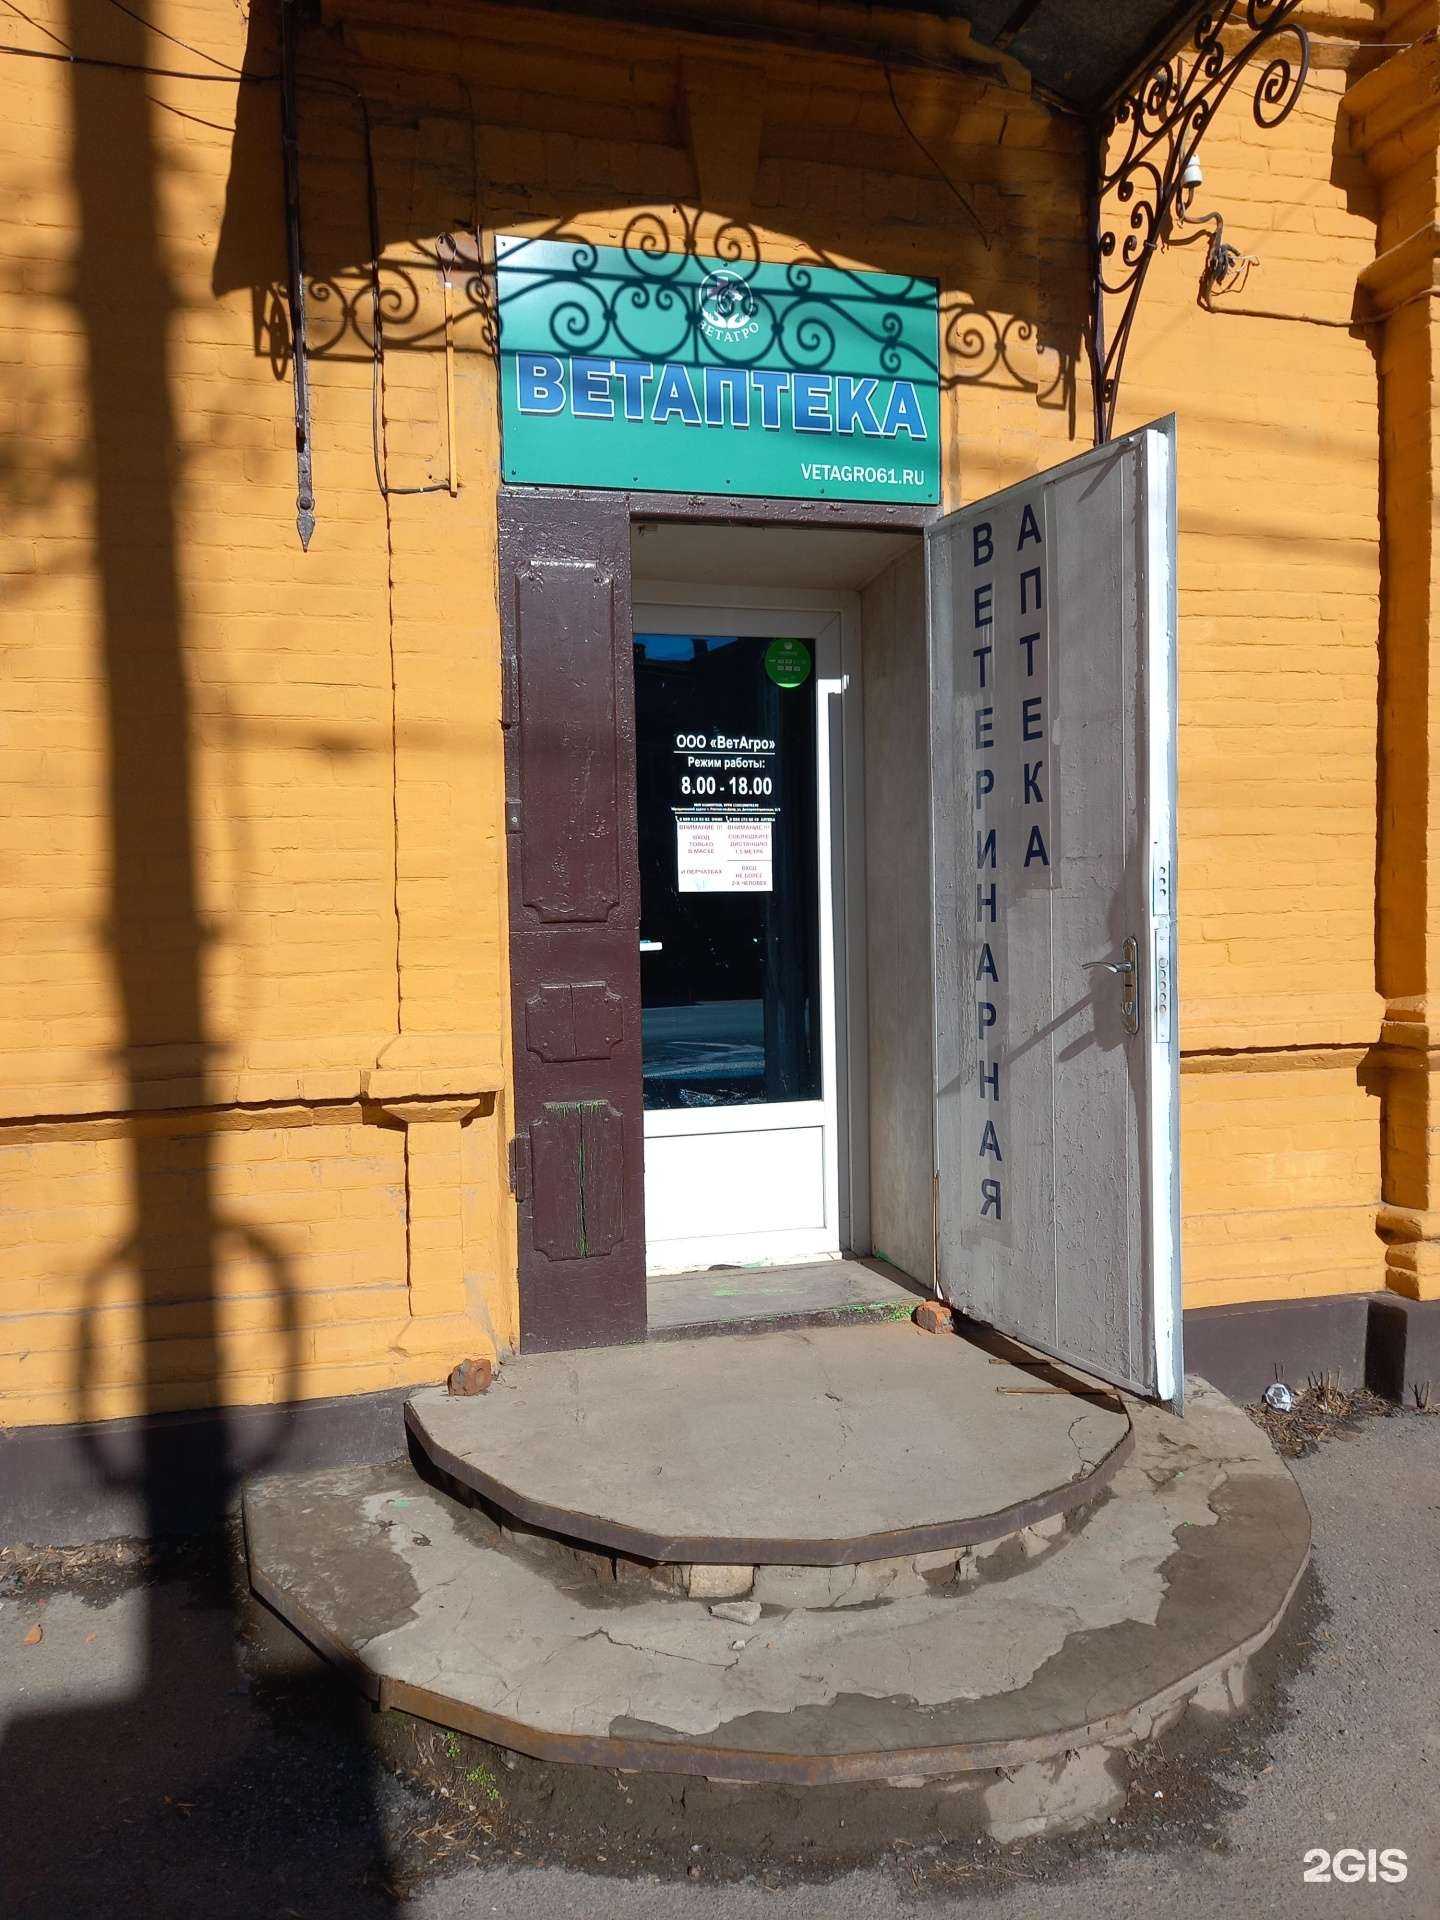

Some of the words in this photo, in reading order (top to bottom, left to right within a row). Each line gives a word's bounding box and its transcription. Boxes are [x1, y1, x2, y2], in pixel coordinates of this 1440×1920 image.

[515, 352, 928, 441] ВЕТАПТЕКА
[800, 463, 925, 486] VETAGRO61.RU
[1016, 503, 1050, 868] АПТЕКА
[676, 734, 707, 748] ООО
[710, 735, 776, 752] «ВетАгро»
[687, 756, 722, 768] Режим
[724, 757, 766, 770] работы:
[681, 776, 716, 795] 8.00
[729, 776, 773, 796] 18.00
[972, 521, 1003, 1220] ВЕТЕРИНАРНАЯ
